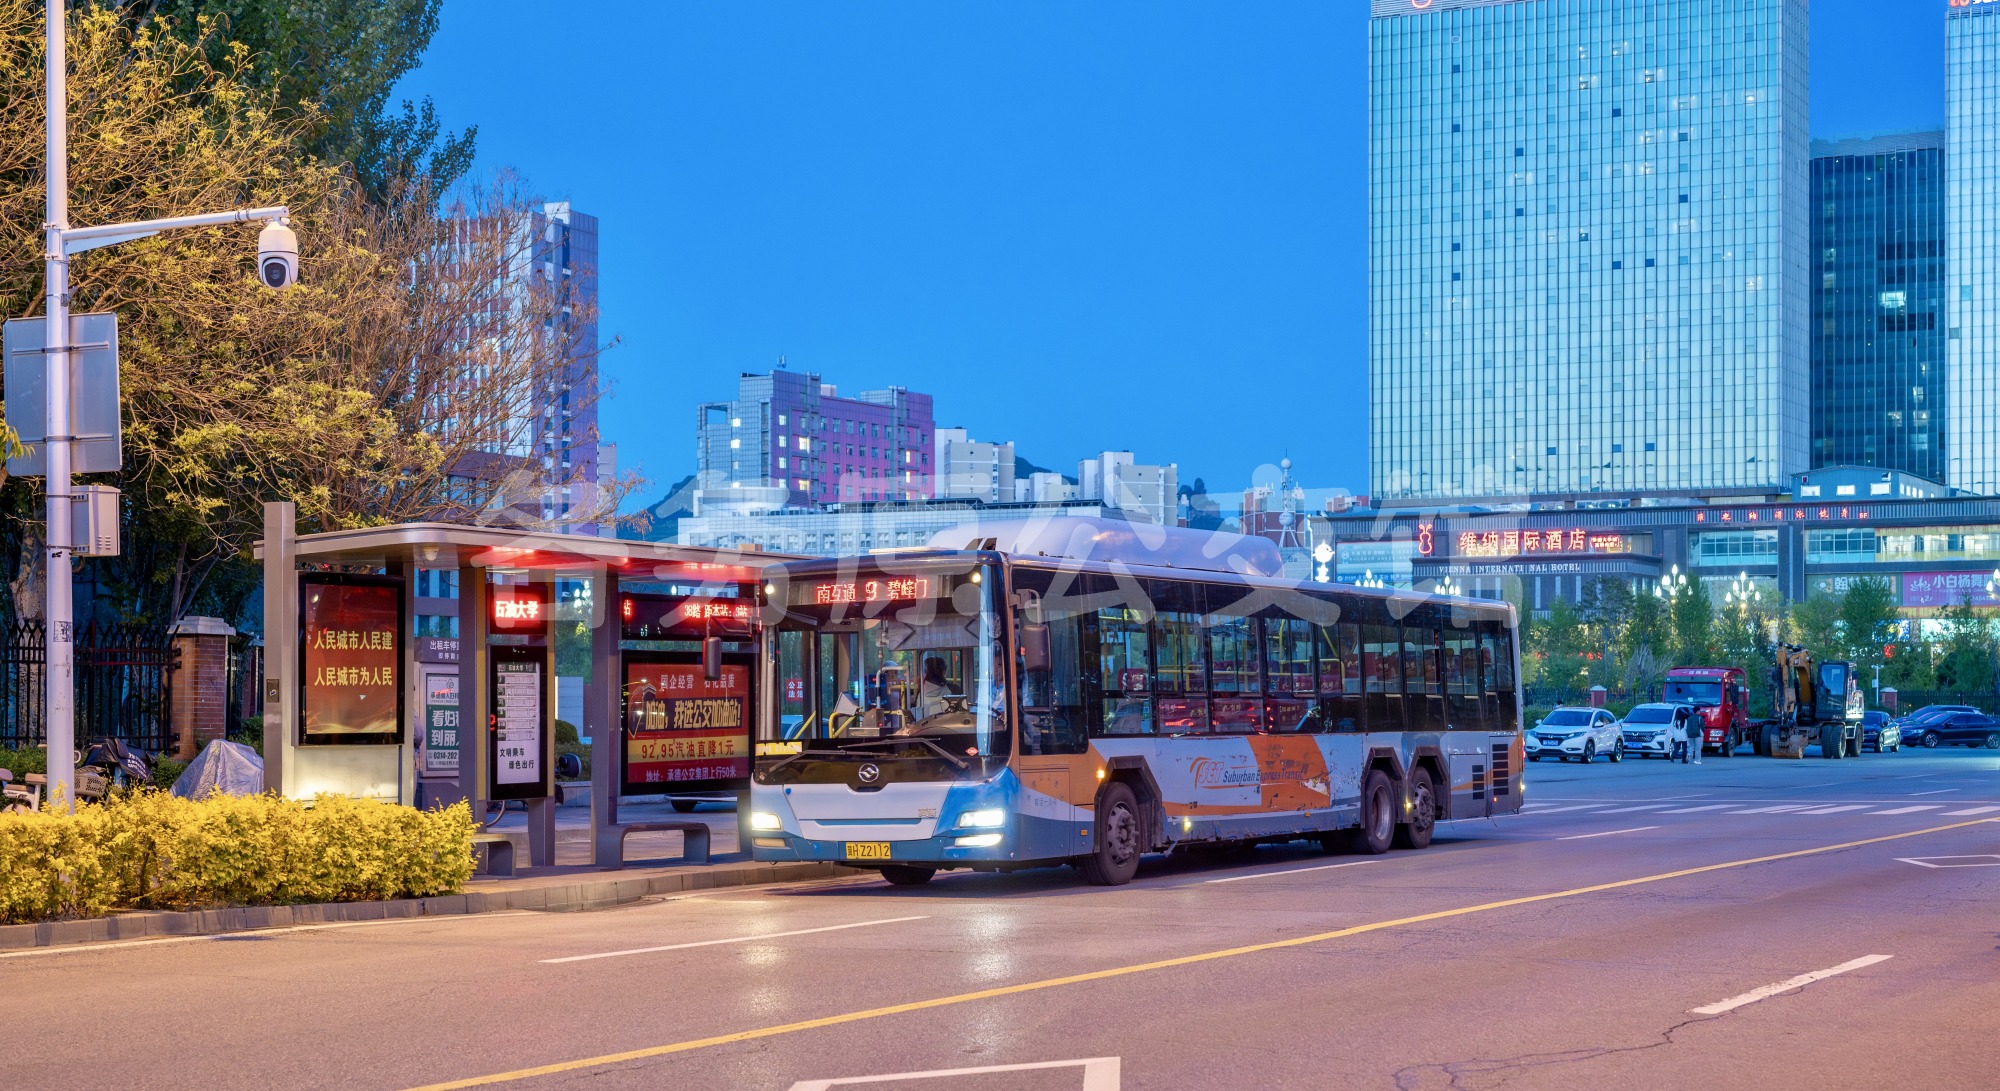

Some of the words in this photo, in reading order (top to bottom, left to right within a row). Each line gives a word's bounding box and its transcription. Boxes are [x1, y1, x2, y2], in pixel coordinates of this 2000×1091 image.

[1459, 529, 1586, 551] 维纳国际酒店
[1439, 565, 1471, 573] VIENNA
[1551, 563, 1580, 571] HOTEL
[816, 583, 857, 604] 南互通
[865, 581, 878, 601] 9
[887, 578, 928, 600] 碧峰门
[495, 600, 539, 619] 石油大学
[313, 630, 393, 650] 人民城市人民建
[429, 640, 459, 651] 出租车停
[314, 666, 393, 687] 人民城市为人民
[660, 674, 694, 690] 国企经营
[431, 730, 459, 747] 到丽
[499, 748, 525, 757] 文明乘车
[508, 760, 534, 770] 绿色出行
[1222, 770, 1255, 783] Suburban
